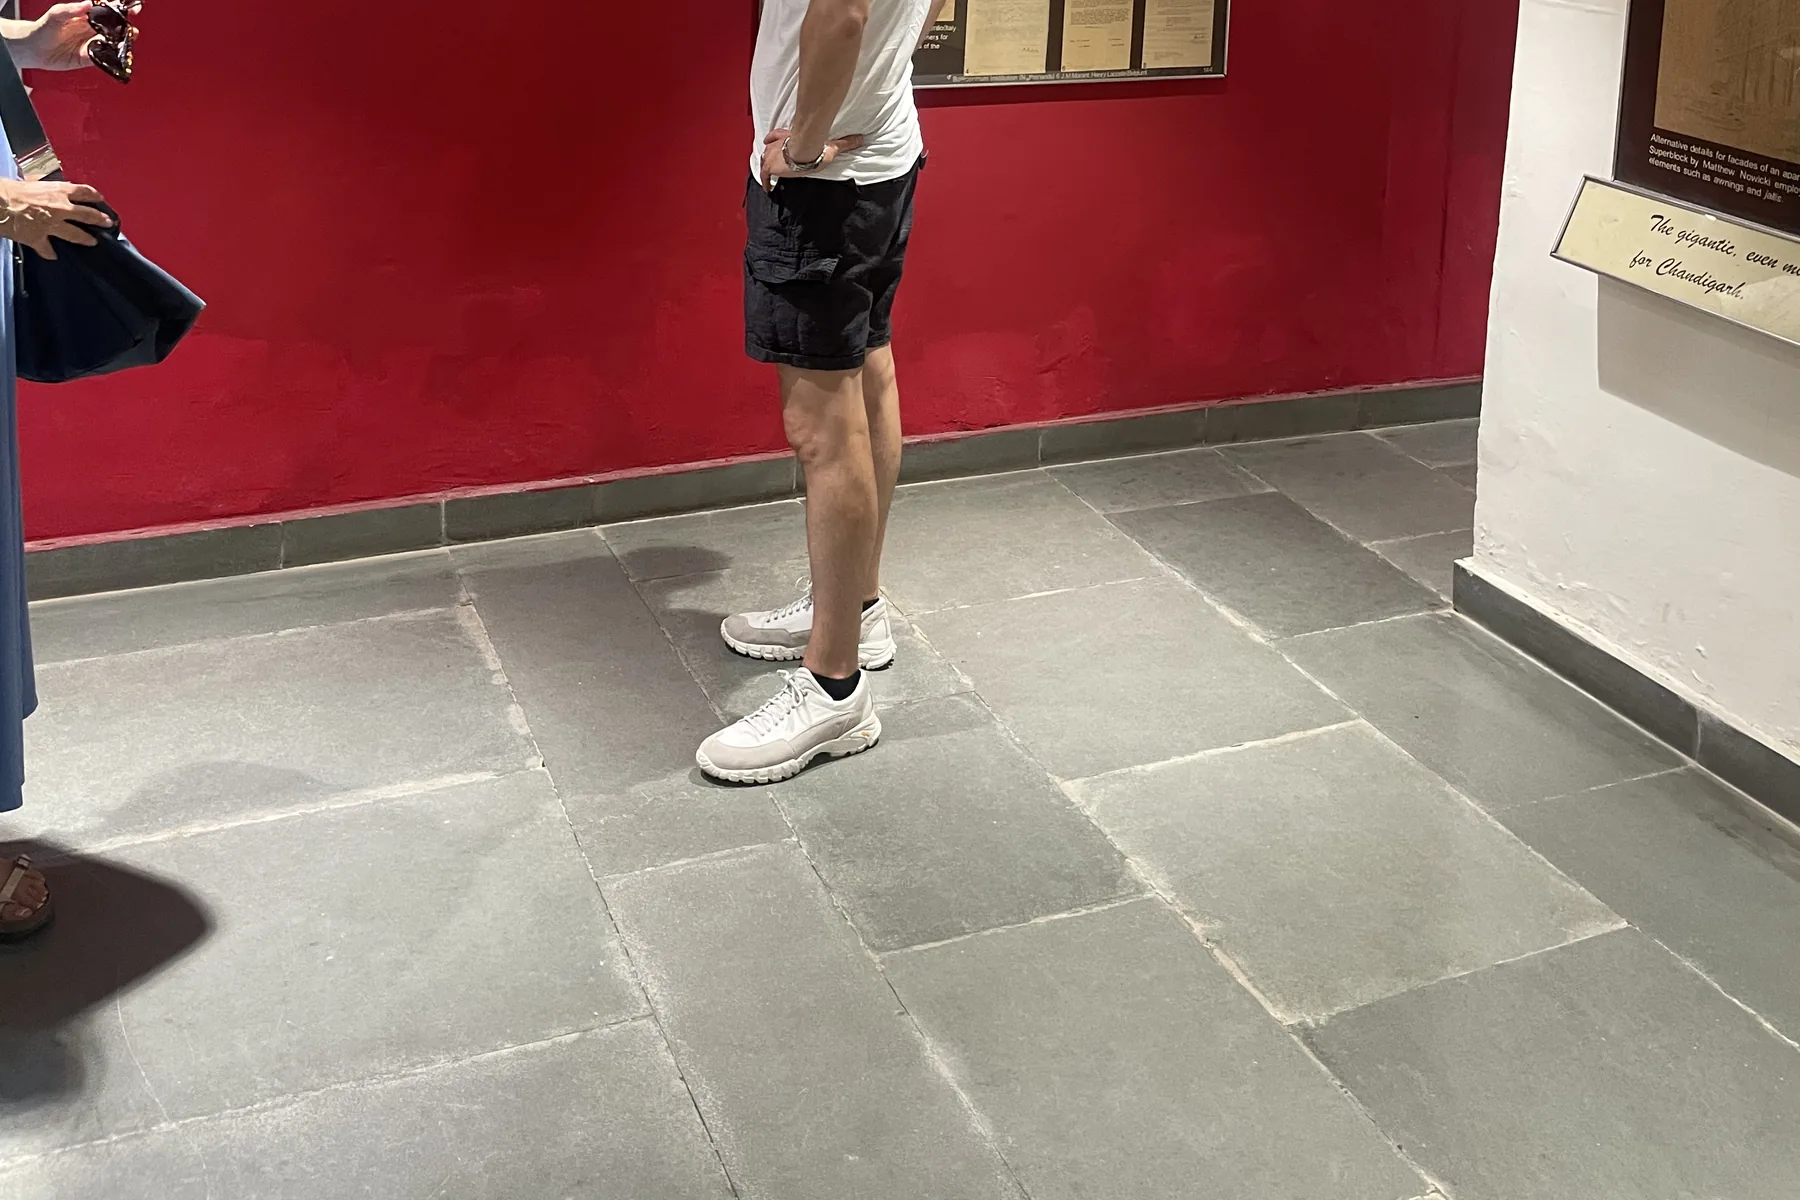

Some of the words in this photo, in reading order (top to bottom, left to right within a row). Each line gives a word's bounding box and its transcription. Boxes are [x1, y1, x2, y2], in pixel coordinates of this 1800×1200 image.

[1649, 145, 1688, 163] Superblock
[1690, 158, 1699, 168] by
[1703, 160, 1735, 176] Matthew
[1740, 170, 1771, 186] Nowicki
[1649, 157, 1681, 173] elements
[1683, 167, 1700, 179] such
[1702, 174, 1711, 182] as
[1713, 176, 1744, 193] awnings
[1747, 187, 1762, 197] and
[1651, 133, 1689, 151] Alternative
[1690, 145, 1713, 158] details
[1716, 150, 1726, 161] for
[1728, 154, 1758, 170] facades
[1760, 164, 1769, 173] of
[1770, 167, 1780, 177] an
[1651, 214, 1673, 236] The
[1677, 229, 1737, 258] gigantic,
[1746, 251, 1778, 269] even
[1629, 250, 1651, 268] for
[1656, 258, 1746, 300] Chandigarh.
